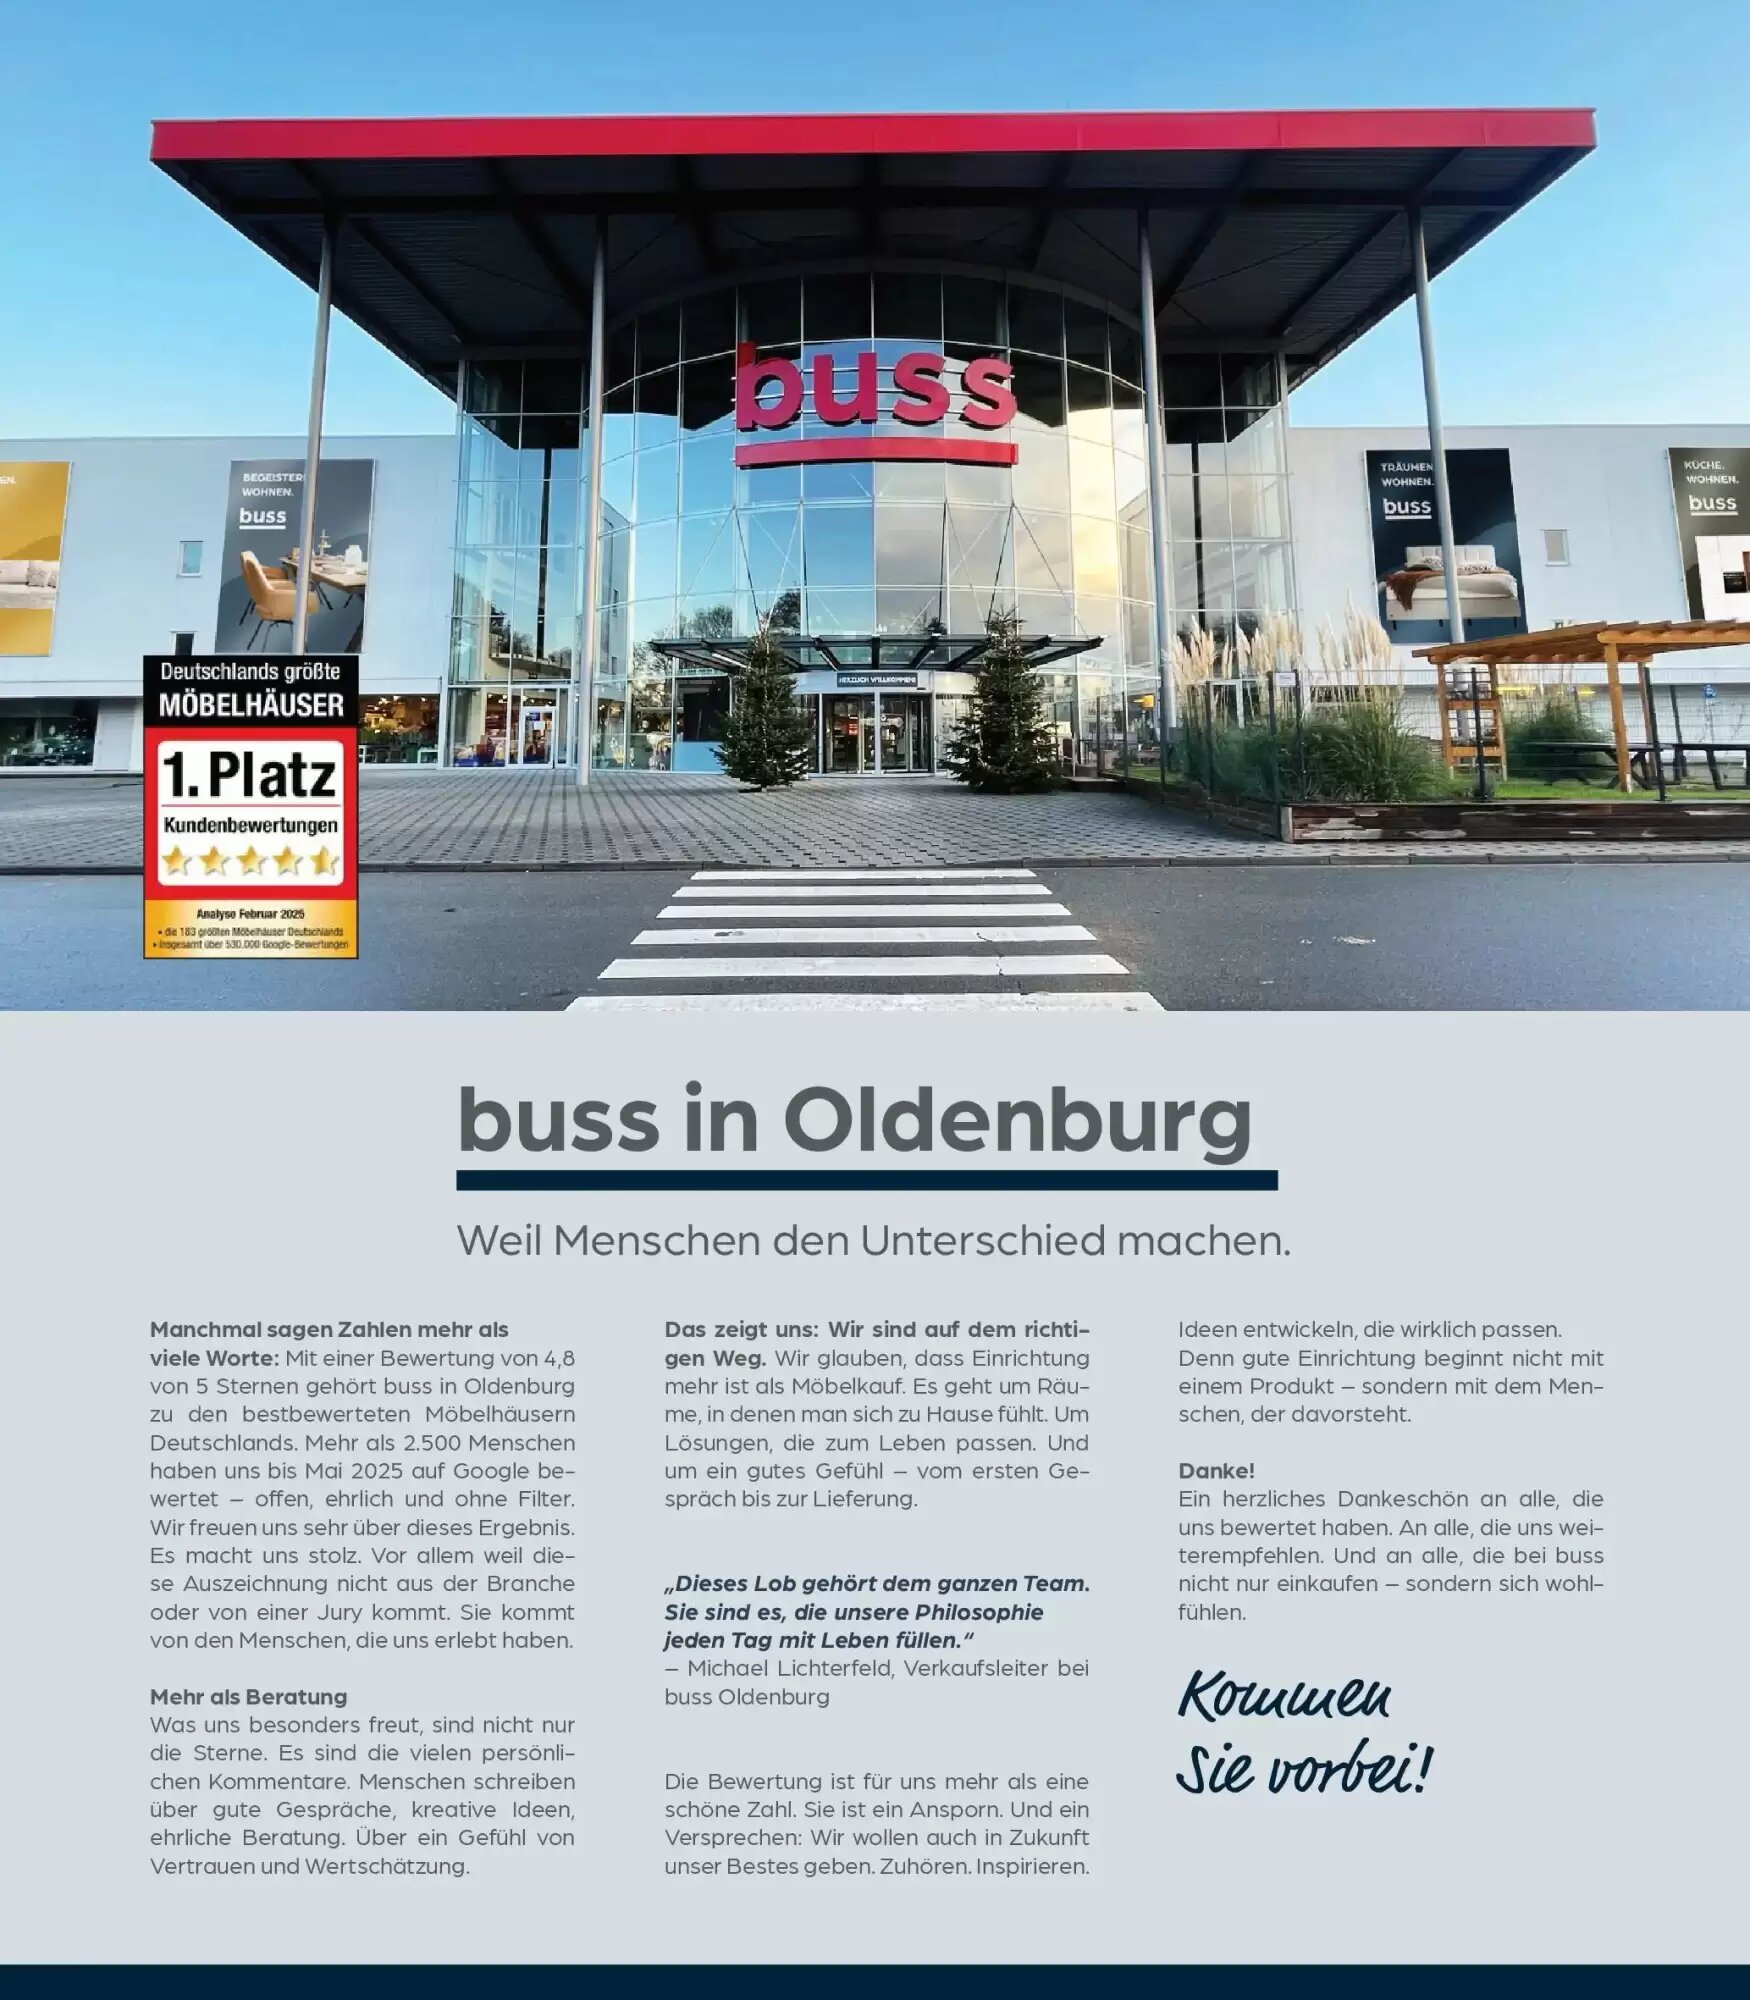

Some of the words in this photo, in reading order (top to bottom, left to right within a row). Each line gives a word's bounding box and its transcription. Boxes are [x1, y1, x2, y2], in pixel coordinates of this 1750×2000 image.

[736, 342, 1018, 430] buss
[1381, 477, 1435, 487] WOHNEN.
[1686, 475, 1739, 485] WOHNEN.
[242, 487, 293, 497] WOHNEN.
[1383, 498, 1431, 514] buss
[1689, 495, 1737, 511] buss
[240, 507, 286, 524] buss
